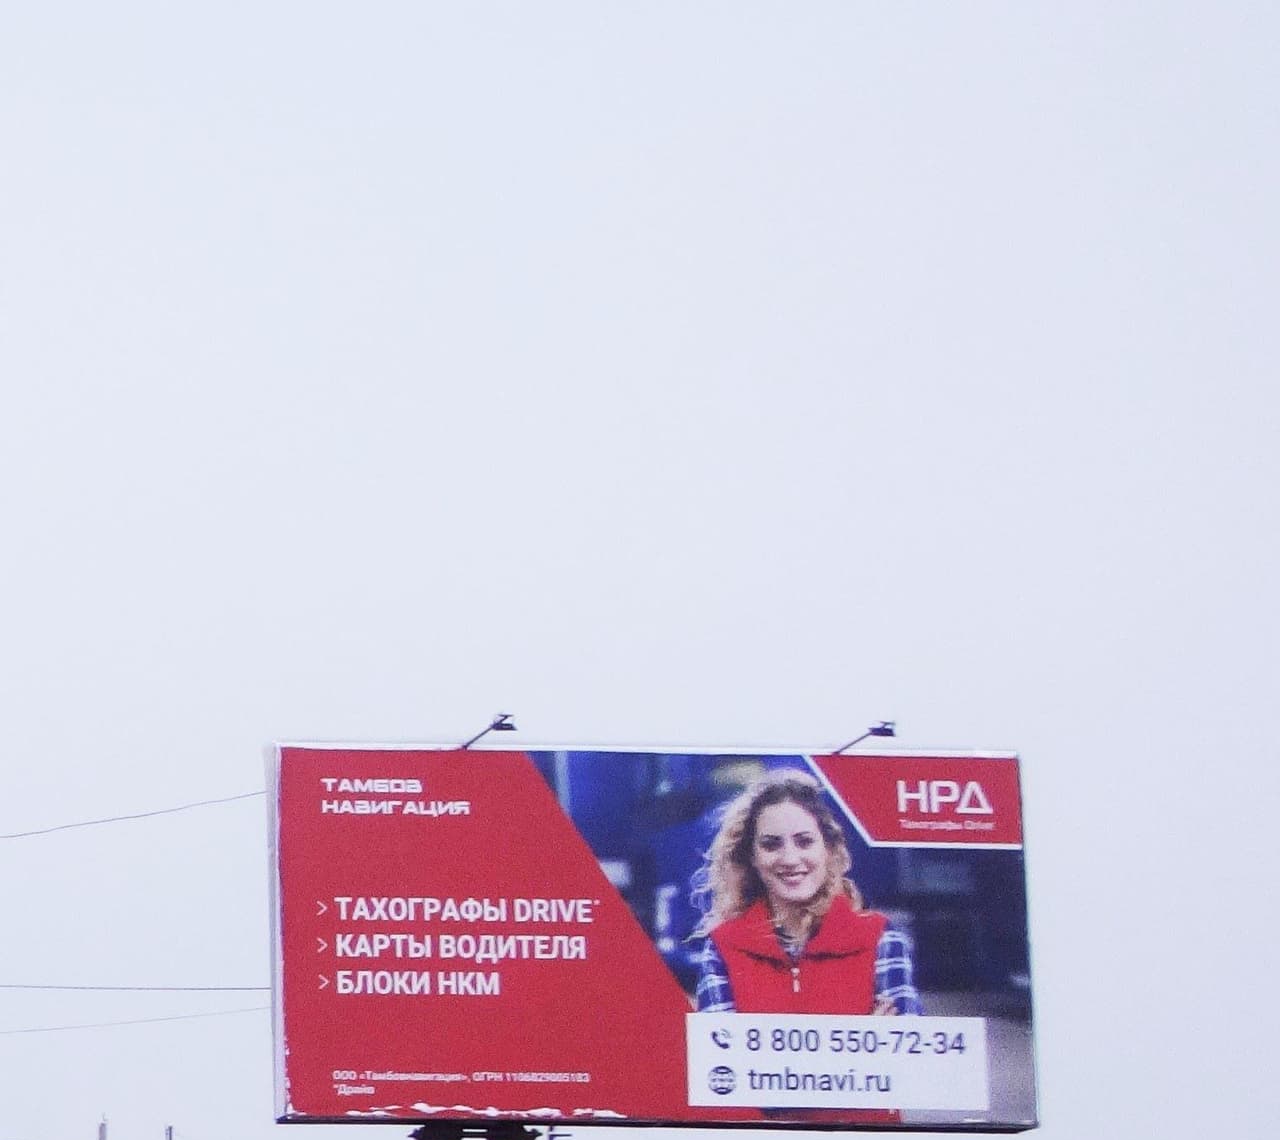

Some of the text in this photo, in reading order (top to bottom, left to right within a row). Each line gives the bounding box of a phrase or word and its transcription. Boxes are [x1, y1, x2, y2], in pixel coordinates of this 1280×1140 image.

[320, 777, 423, 794] ТАМБОВ
[321, 799, 472, 817] НАВИГАЦИЯ
[334, 897, 507, 922] ТАХОГРАФЫ
[335, 933, 587, 963] КАРТЫ ВОДИТЕЛЯ
[336, 970, 501, 996] БЛОКИ НКМ
[746, 1028, 967, 1055] 8 800 550-72-34
[748, 1067, 890, 1092] tmbnavi.ru
